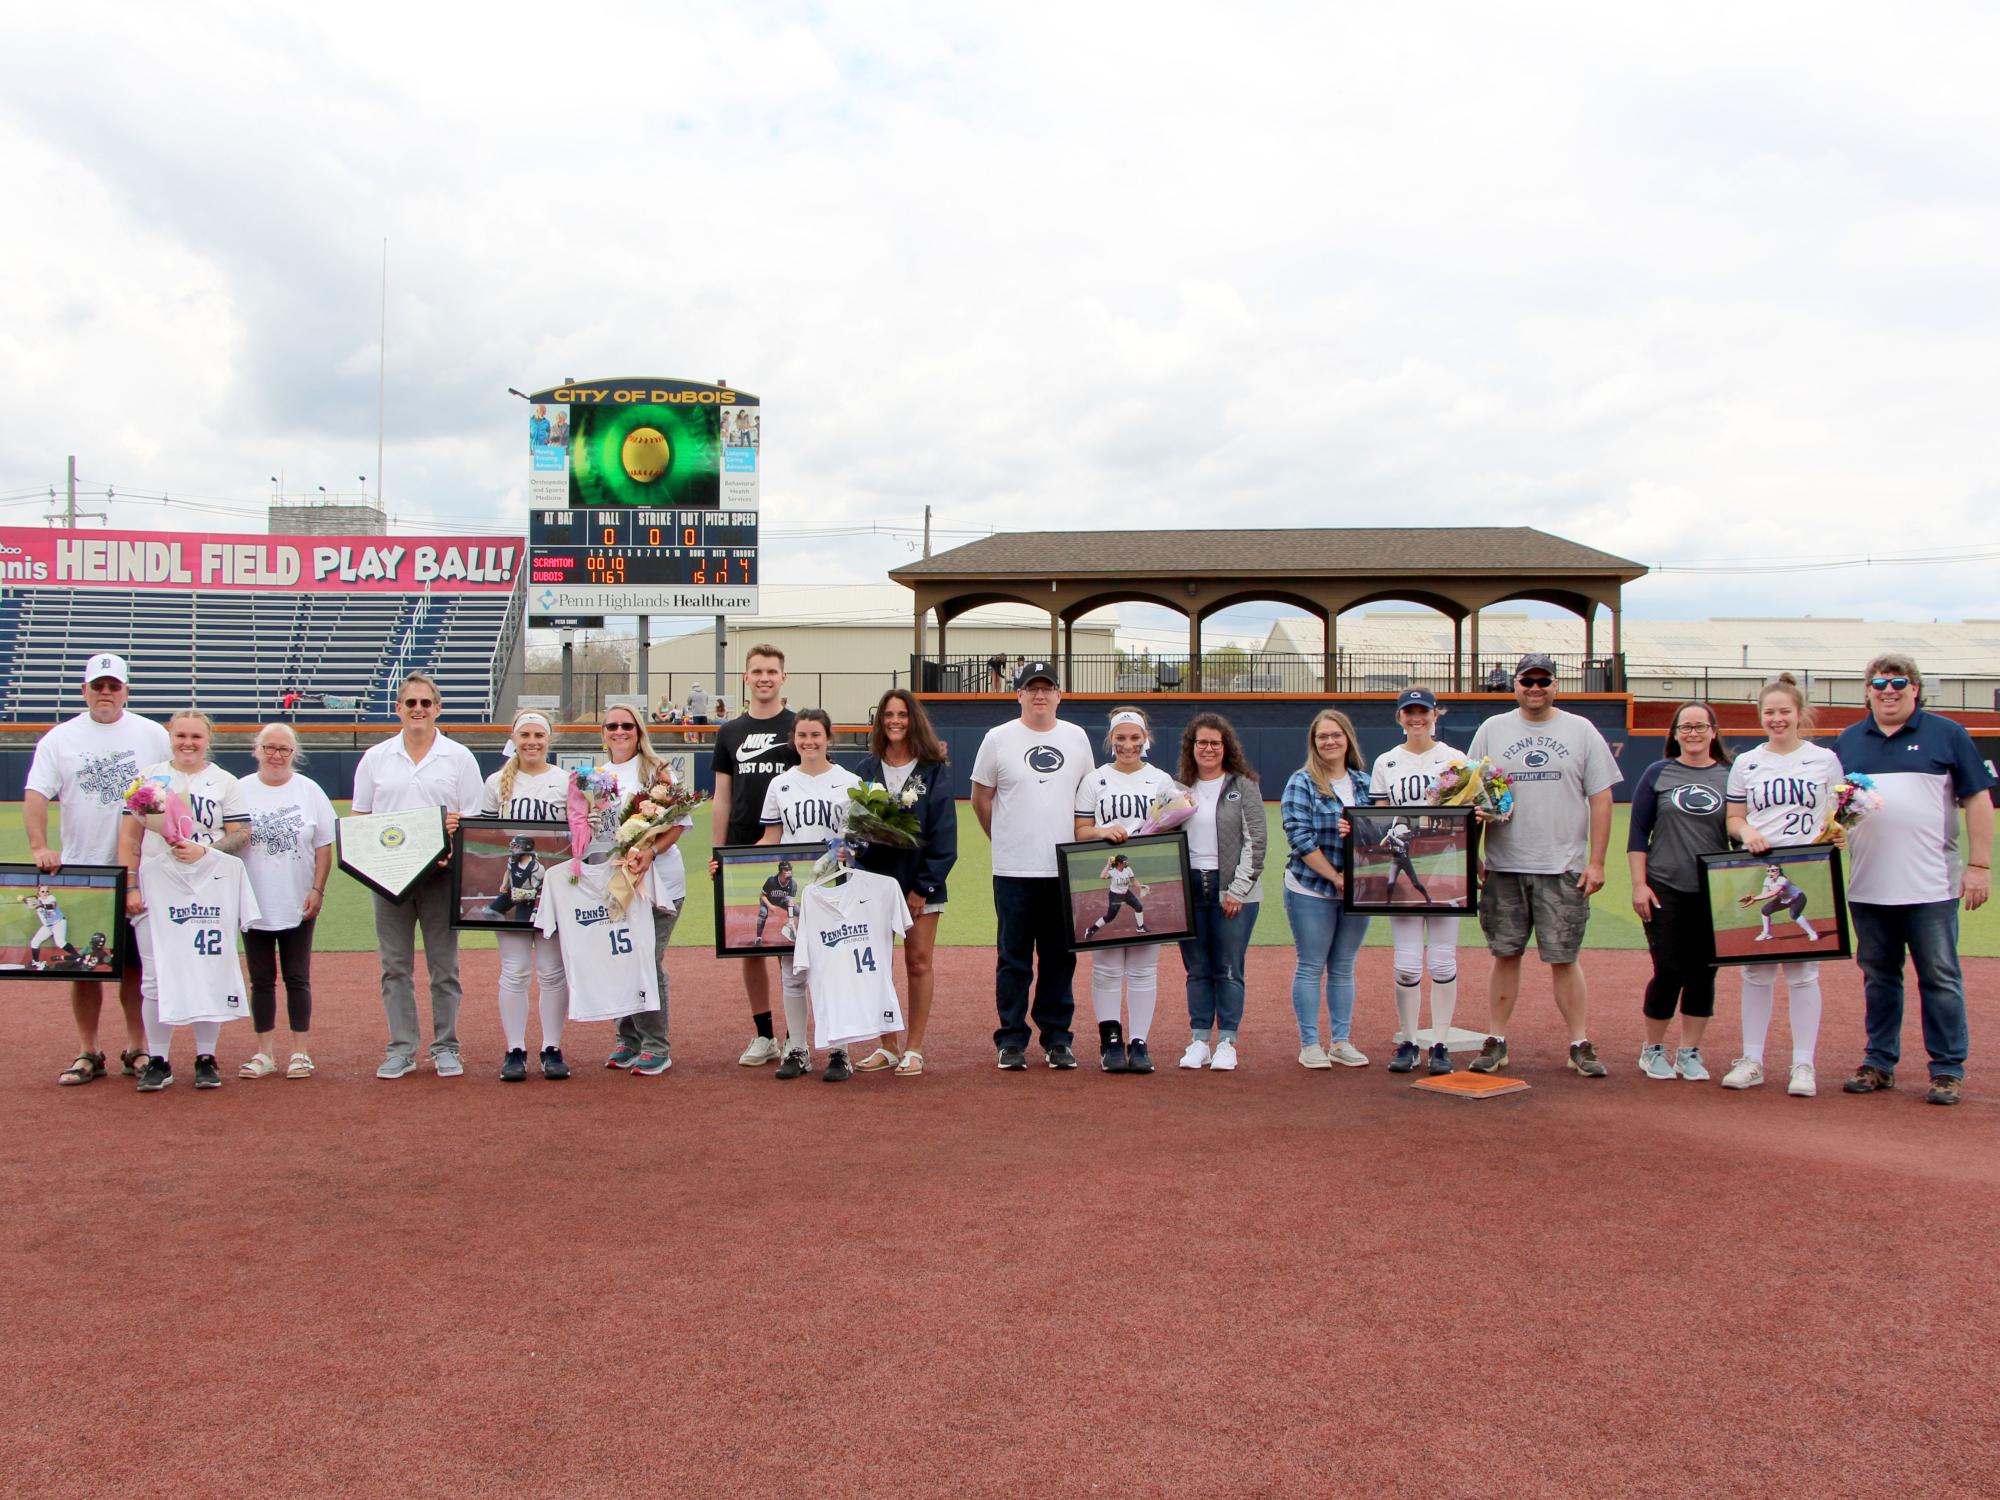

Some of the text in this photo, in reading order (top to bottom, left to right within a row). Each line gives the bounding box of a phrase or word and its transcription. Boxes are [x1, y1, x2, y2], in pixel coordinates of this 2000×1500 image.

[554, 389, 736, 404] CITY OF DuBOIS
[544, 512, 573, 525] AT BAT
[598, 512, 620, 526] BALL
[638, 512, 672, 526] STRIKE
[681, 512, 700, 526] OUT
[705, 513, 756, 526] PITCH SPEED
[604, 528, 615, 545] 0
[649, 528, 660, 546] 0
[684, 528, 695, 546] 0
[56, 538, 301, 586] HEINDL FIELD
[313, 544, 515, 583] PLAY BALL!
[533, 557, 574, 569] SCRANTON
[740, 558, 748, 570] 4
[533, 571, 564, 582] DUBOIS
[694, 571, 705, 583] 15
[716, 571, 727, 583] 17
[559, 594, 751, 610] Penn Highlands Healthcare
[742, 733, 777, 749] NIKE
[1502, 736, 1571, 760] PENN STATE
[738, 762, 757, 774] JUST
[758, 762, 773, 774] DO
[1390, 775, 1436, 805] LIO
[1750, 777, 1818, 812] LIONS
[783, 799, 843, 836] LIONS
[1100, 794, 1156, 825] LION
[1783, 812, 1814, 835] 20
[194, 929, 222, 955] 42
[609, 928, 633, 955] 15
[853, 946, 876, 973] 14
